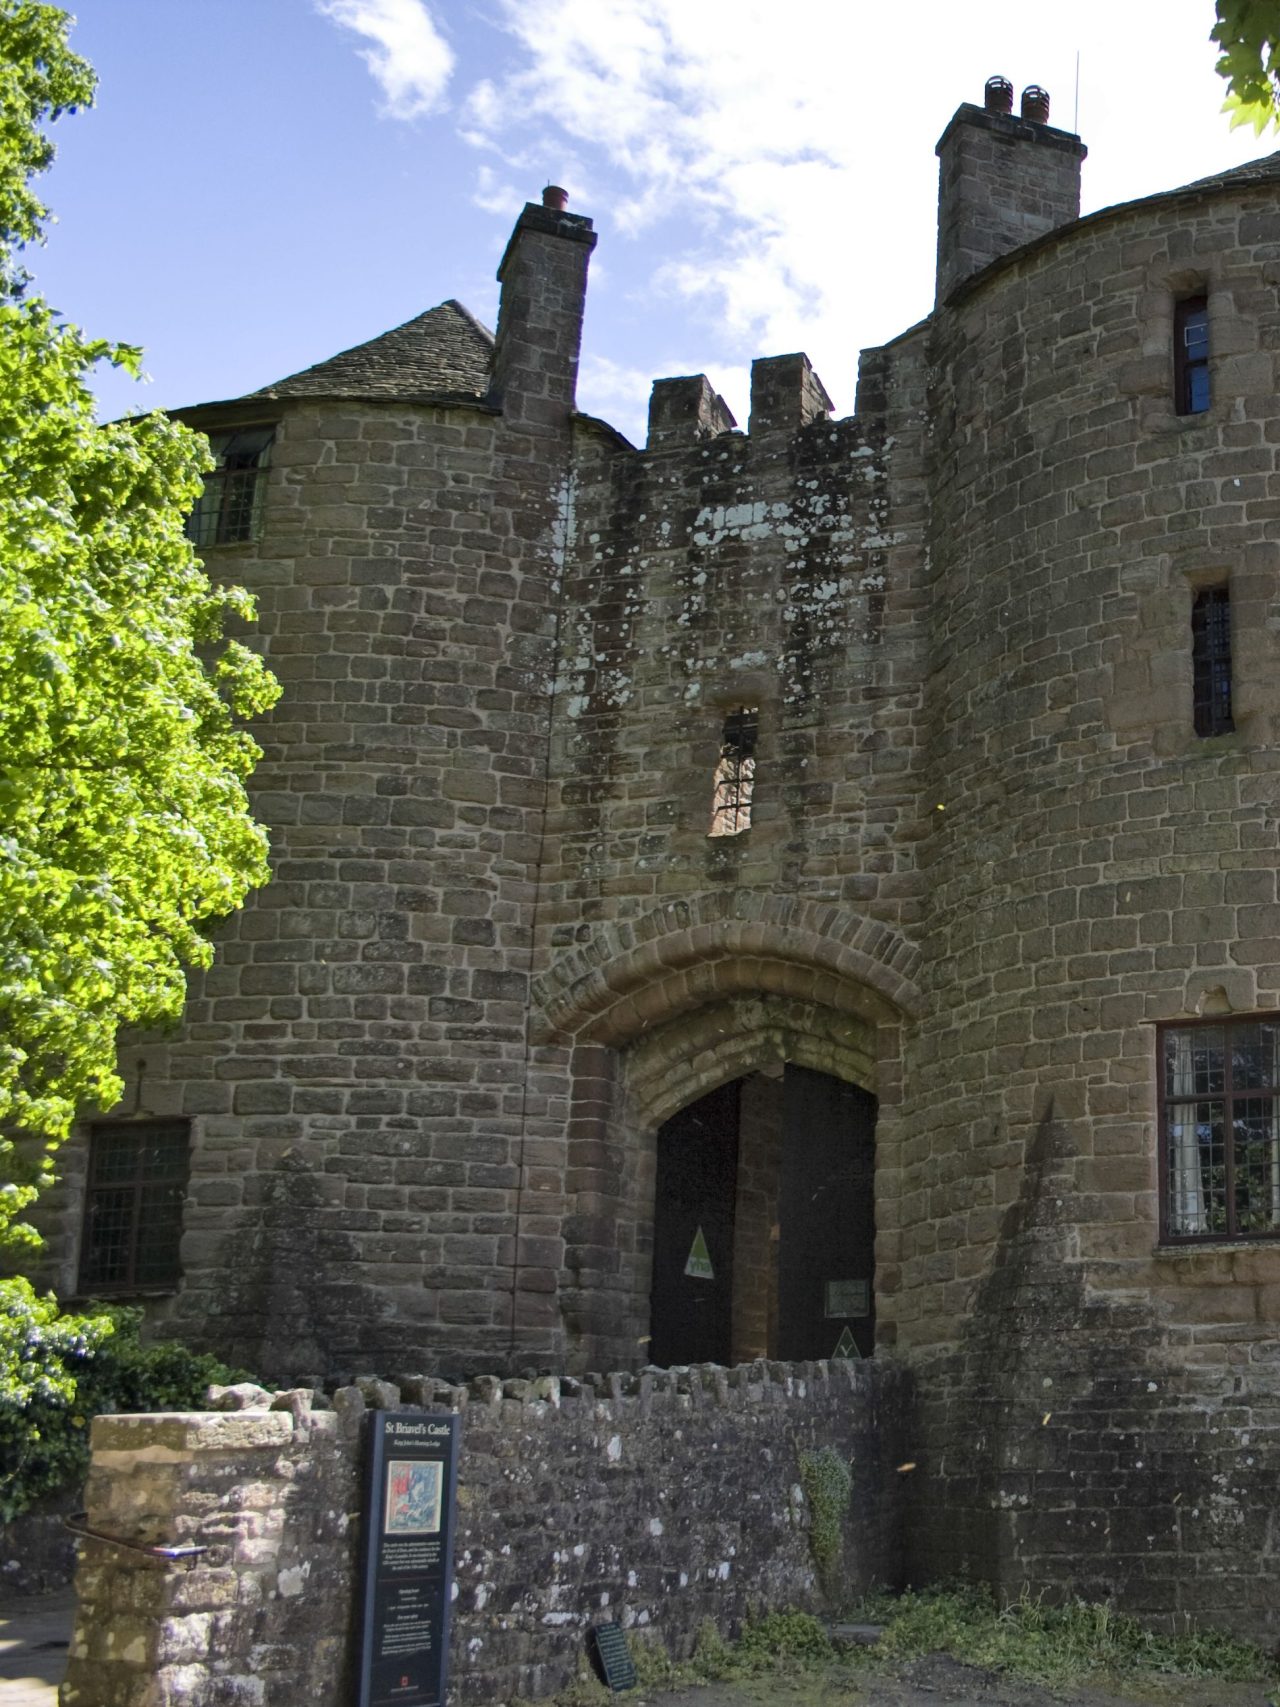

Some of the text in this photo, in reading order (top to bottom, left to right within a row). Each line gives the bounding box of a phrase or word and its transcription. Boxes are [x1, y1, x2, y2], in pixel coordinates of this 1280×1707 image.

[689, 1259, 711, 1274] yha
[385, 1422, 450, 1435] St Briavel's Castle
